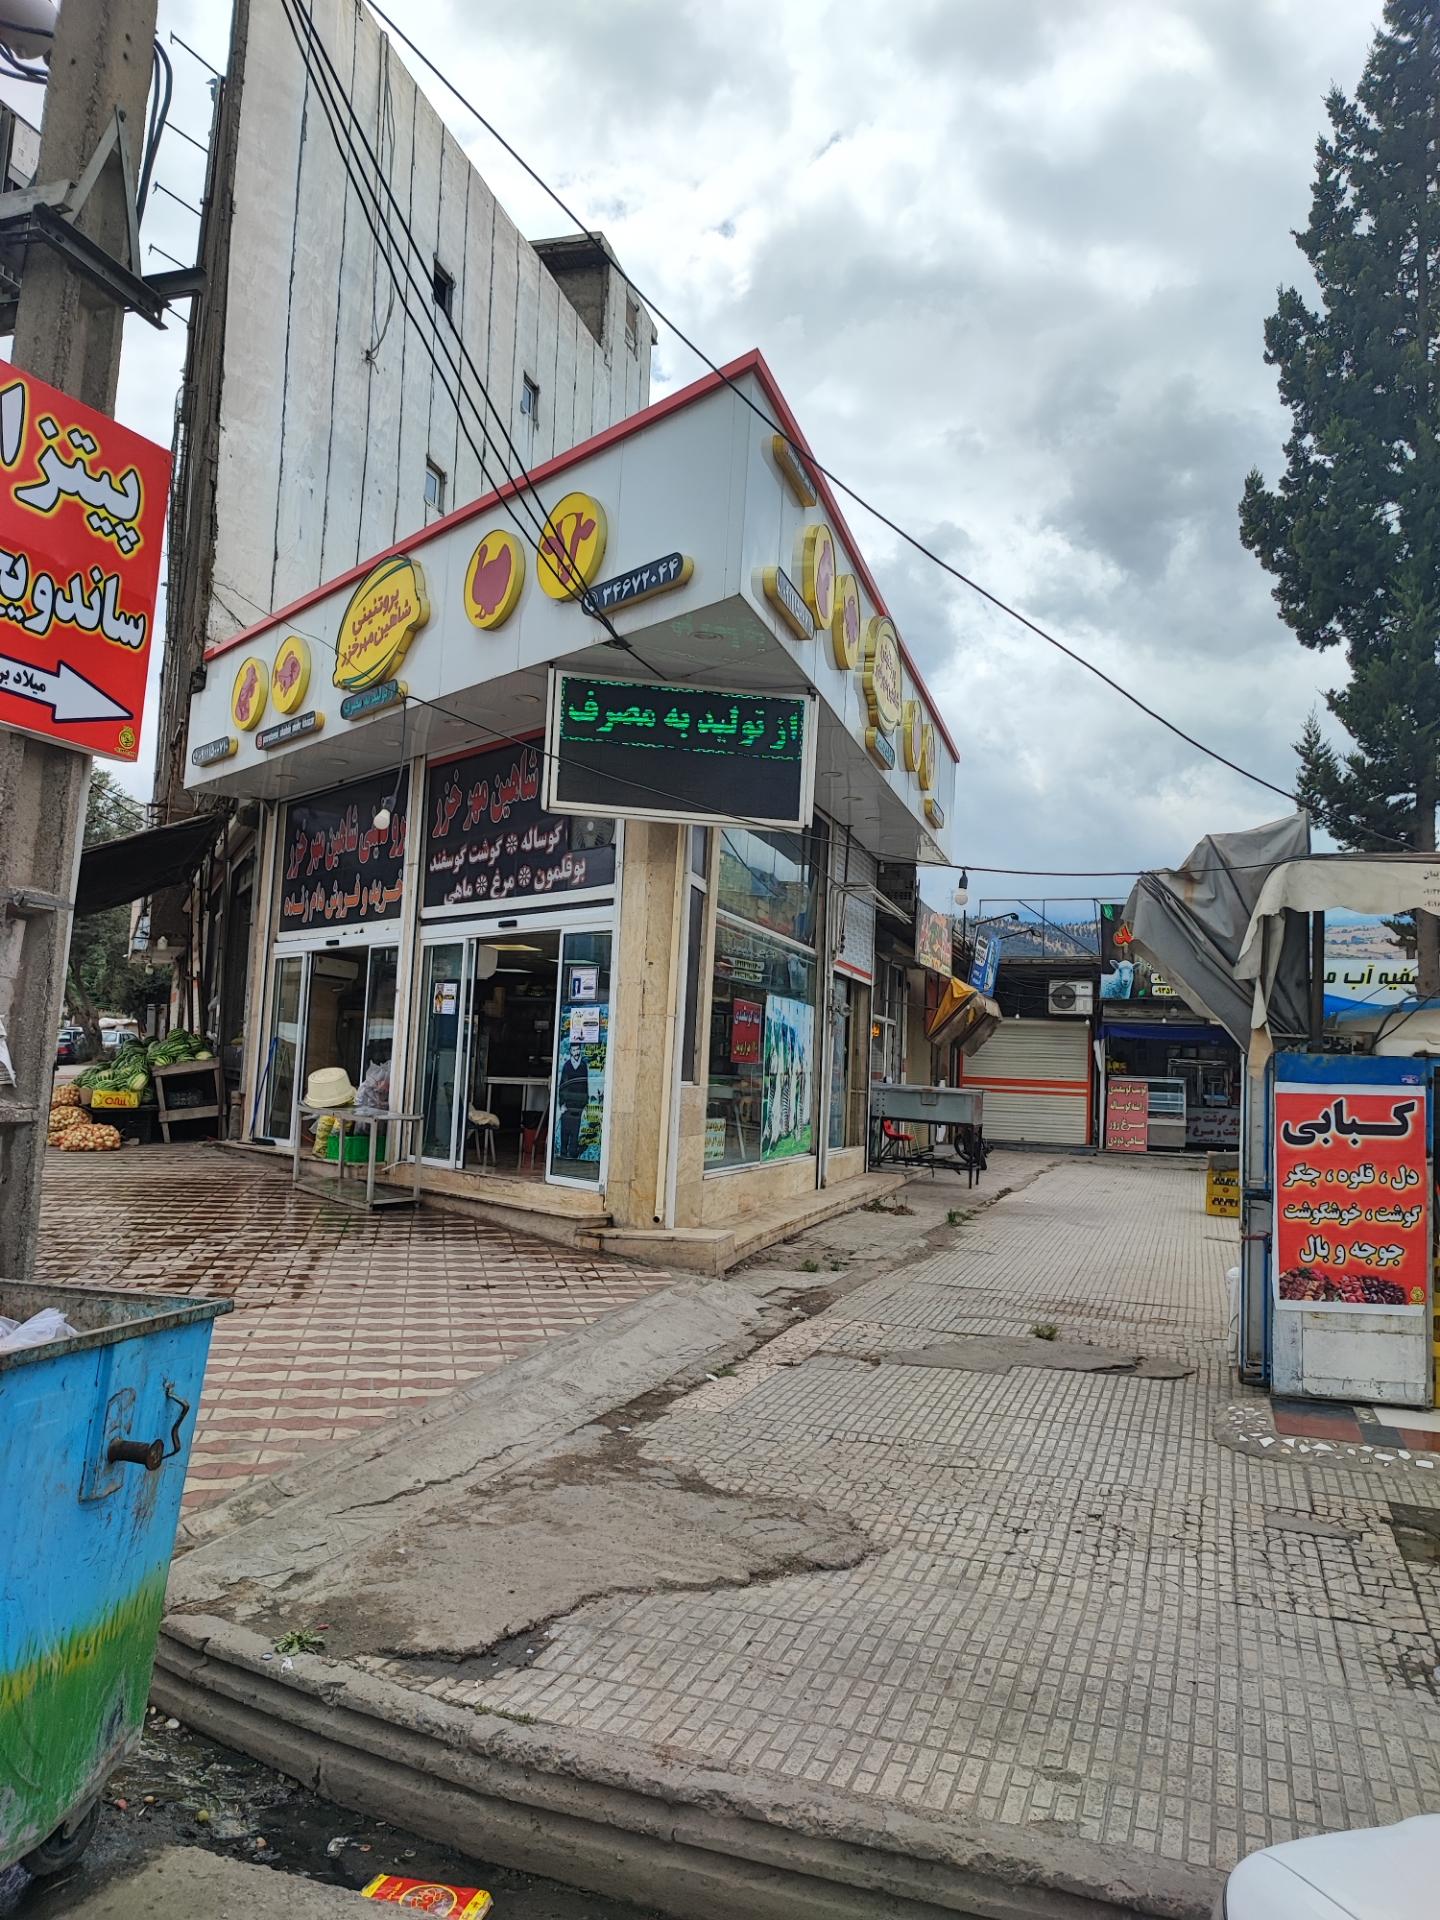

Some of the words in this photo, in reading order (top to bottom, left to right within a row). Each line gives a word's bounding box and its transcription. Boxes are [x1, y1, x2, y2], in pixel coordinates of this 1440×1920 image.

[602, 557, 680, 607] ۳۴۶۷۲۰۴۴
[373, 599, 412, 647] شاهین
[13, 669, 47, 696] میلاد
[567, 689, 657, 733] مصرف
[663, 706, 691, 740] به
[697, 705, 766, 748] تولید
[769, 711, 800, 750] از
[431, 768, 463, 839] خزر
[462, 779, 490, 832] مهر
[489, 748, 540, 824] شاهین
[286, 818, 308, 880] خزر
[306, 829, 326, 877] مهر
[324, 803, 360, 871] شاهین
[309, 881, 326, 922] دام
[324, 873, 361, 920] فروش
[368, 868, 404, 914] خرید
[443, 875, 474, 906] ماهی
[489, 867, 516, 899] مرغ
[1343, 963, 1375, 991] آب
[1378, 967, 1418, 991] فیه
[1282, 1098, 1416, 1147] کبابی
[1283, 1163, 1322, 1188] جگر
[1336, 1162, 1376, 1187] قلوه
[1391, 1166, 1420, 1191] دل
[1283, 1202, 1361, 1226] خوشگوشت
[1375, 1204, 1422, 1228] گوشت
[1299, 1234, 1330, 1264] بال
[1334, 1248, 1347, 1265] و
[1349, 1241, 1405, 1266] جوجه
